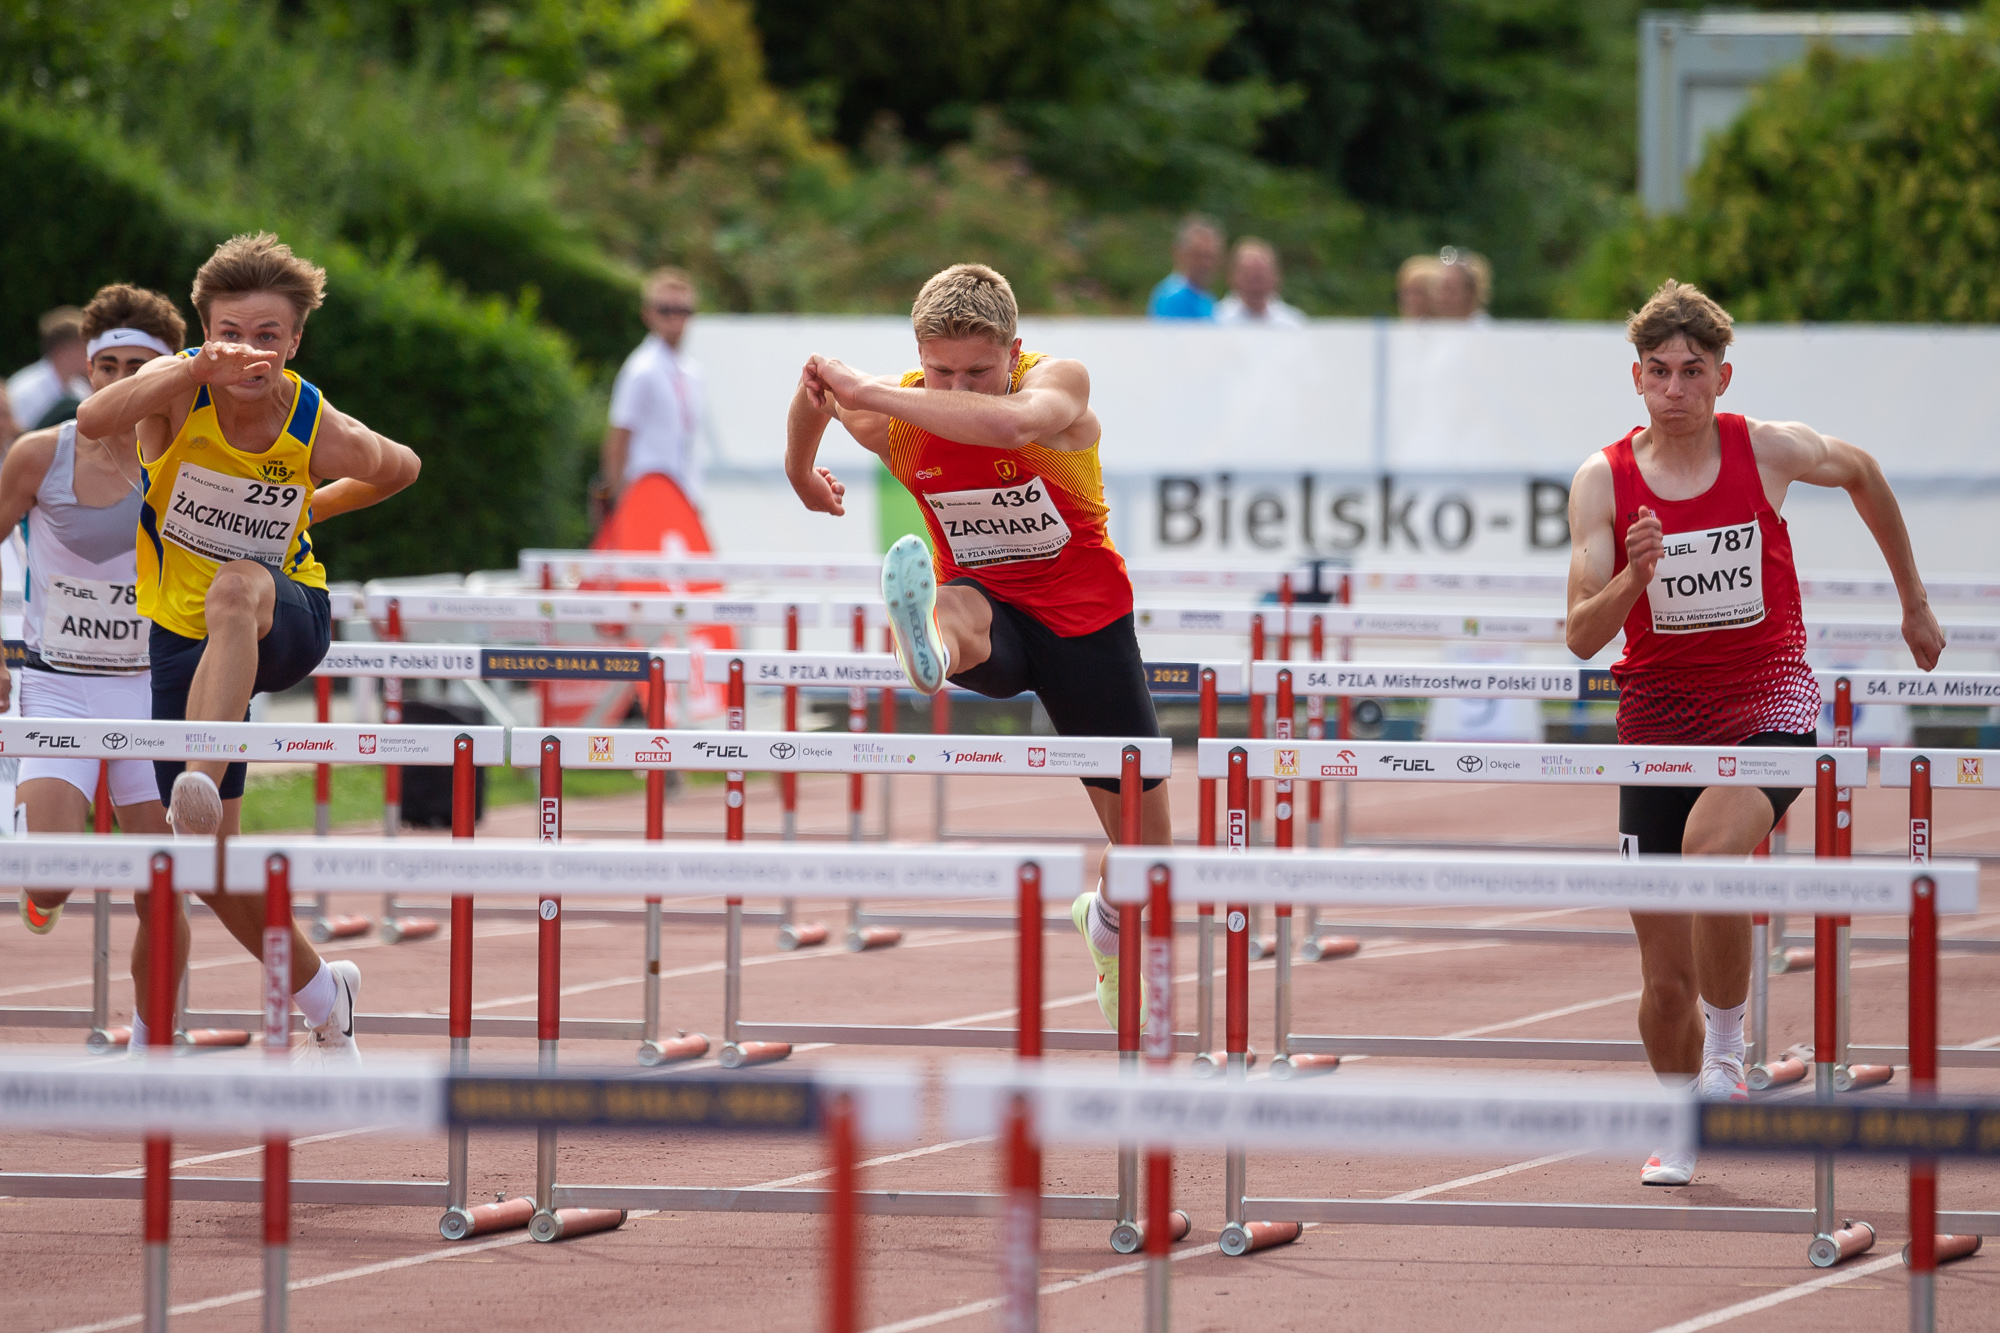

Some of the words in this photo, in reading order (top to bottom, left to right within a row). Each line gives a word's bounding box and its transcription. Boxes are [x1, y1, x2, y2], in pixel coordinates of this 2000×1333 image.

[262, 465, 287, 477] VIS
[915, 466, 943, 480] esa
[190, 475, 234, 493] MAŁOPOLSKA
[243, 483, 298, 508] 259
[991, 484, 1041, 508] 436
[173, 491, 290, 541] ŻACZKIEWICZ
[1157, 474, 1570, 550] Bielsko-B
[944, 512, 1058, 537] ZACHARA
[178, 529, 195, 543] PZLA
[196, 539, 242, 558] Mistrzostwa
[267, 555, 283, 563] U18
[1706, 526, 1755, 555] 787
[968, 550, 987, 558] PZLA
[988, 547, 1031, 556] Mistrzostwa
[1032, 543, 1055, 552] Polski
[1661, 566, 1753, 598] TOMYS
[63, 586, 98, 601] FUEL
[1687, 611, 1731, 621] Mistrzostwa
[1733, 605, 1755, 615] Polski
[61, 615, 143, 640] ARNDT
[390, 655, 438, 670] Polski
[444, 656, 475, 670] U18
[488, 656, 599, 673] BIELSKO-BIAŁA
[604, 658, 640, 673] 2022
[759, 665, 784, 679] 54.
[790, 665, 828, 680] PZLA
[1154, 670, 1190, 683] 2022
[1307, 673, 1332, 688] 54.
[1338, 674, 1376, 688] PZLA
[1383, 674, 1481, 690] Mistrzostwa
[1487, 676, 1536, 691] Polski
[1541, 678, 1573, 692] U18
[1866, 681, 1892, 696] 54.
[1899, 681, 1937, 696] PZLA
[39, 736, 81, 749] FUEL
[135, 738, 165, 747] Okęcie
[185, 732, 207, 743] NESTLÉ
[380, 737, 416, 745] Ministerstwo
[185, 743, 221, 753] HEALTHIER
[222, 744, 238, 753] KIDS
[286, 739, 335, 753] polanik
[706, 746, 748, 758] FUEL
[803, 747, 833, 758] Okęcie
[853, 743, 875, 753] NESTLÉ
[876, 745, 884, 753] for
[636, 753, 670, 762] ORLEN
[853, 754, 889, 763] HEALTHIER
[891, 755, 906, 763] KIDS
[954, 751, 1004, 764] polanik
[1049, 751, 1086, 759] Ministerstwo
[1541, 755, 1563, 765] NESTLÉ
[1073, 760, 1099, 768] Turystyki
[1275, 766, 1298, 775] PZLA
[1323, 766, 1356, 775] ORLEN
[1392, 759, 1435, 772] FUEL
[1490, 760, 1521, 771] Okęcie
[1541, 766, 1577, 775] HEALTHIER
[1580, 766, 1595, 775] KIDS
[1645, 761, 1694, 775] polanik
